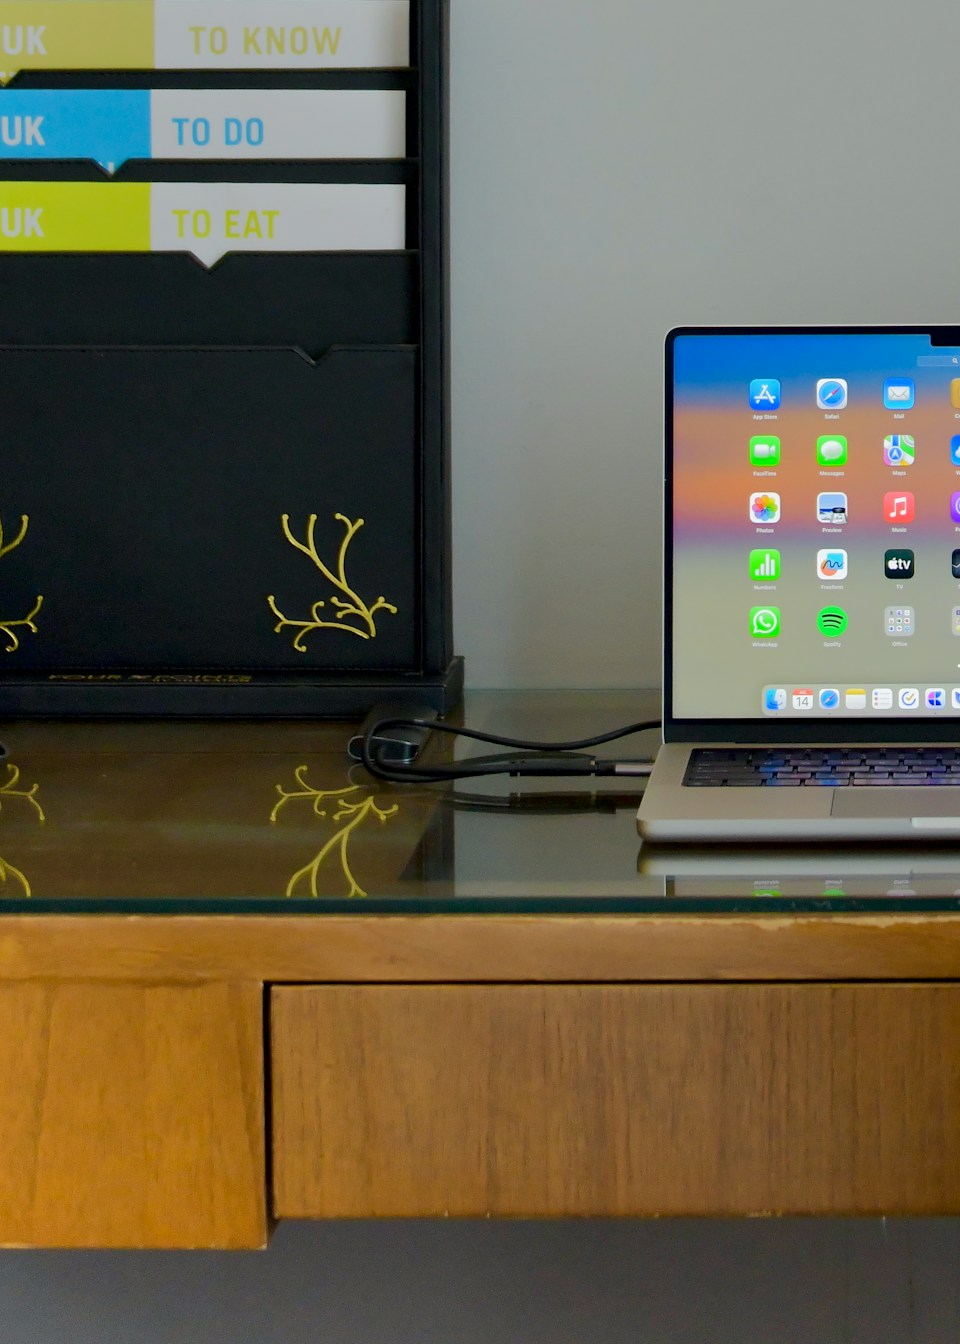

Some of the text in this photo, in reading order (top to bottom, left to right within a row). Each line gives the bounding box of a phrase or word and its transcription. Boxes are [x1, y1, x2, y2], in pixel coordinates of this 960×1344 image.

[2, 24, 47, 56] UK
[188, 25, 342, 56] TO KNOW
[0, 115, 46, 146] UK
[171, 116, 264, 146] TO DO
[0, 206, 46, 238] UK
[171, 208, 280, 239] TO EAT
[898, 556, 912, 571] tv
[751, 641, 779, 649] WhatsApp
[796, 696, 809, 707] 14
